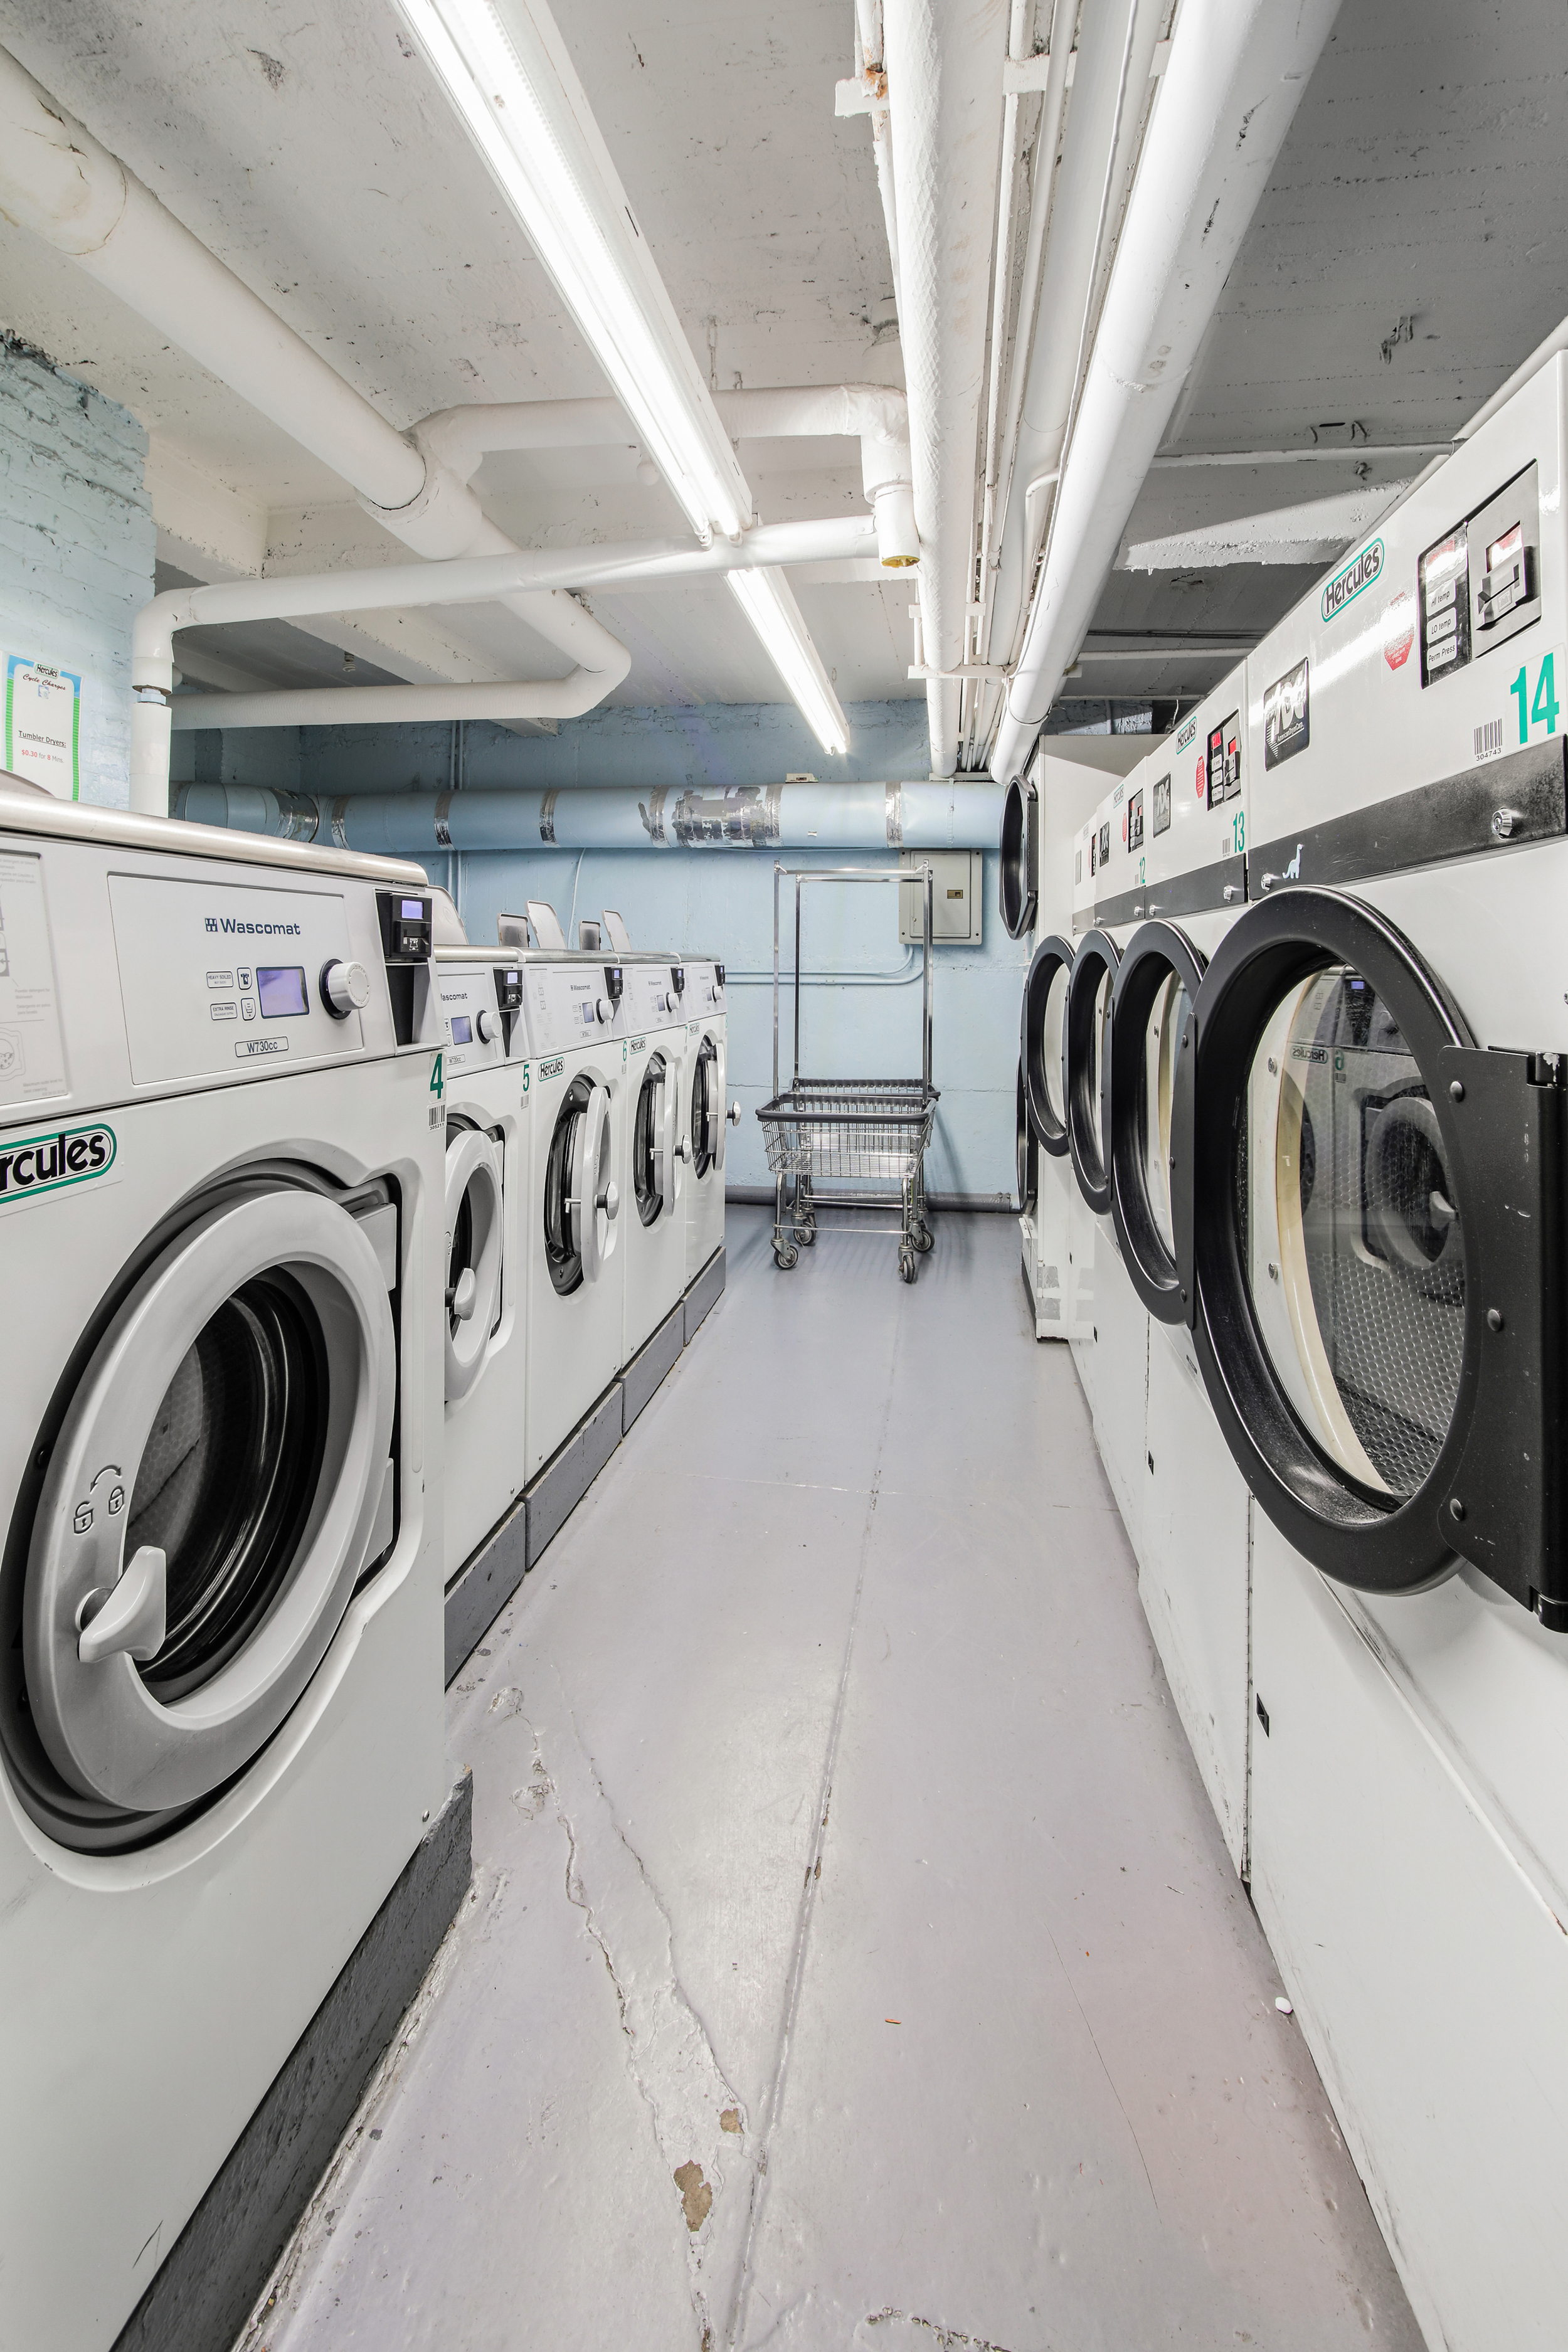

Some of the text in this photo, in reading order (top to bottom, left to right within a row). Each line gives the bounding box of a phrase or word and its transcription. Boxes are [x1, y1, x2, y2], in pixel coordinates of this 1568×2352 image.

[1325, 546, 1379, 614] Hercules
[1431, 591, 1450, 607] HI temp
[1431, 618, 1451, 634] LO temp
[1428, 645, 1455, 663] Perm Press
[36, 664, 58, 677] Hercules
[23, 673, 66, 691] Cycle Charges
[1510, 652, 1560, 744] 14
[18, 730, 66, 747] Tumbler Dryers:
[1177, 721, 1195, 750] Hercules
[21, 750, 38, 758] $0.30
[52, 755, 65, 763] Mins.
[1476, 748, 1502, 761] 304743
[1233, 811, 1244, 853] 13
[1140, 857, 1145, 884] 12
[220, 918, 300, 935] Wascomat
[685, 1026, 687, 1043] 7
[246, 1041, 278, 1053] W730cc
[623, 1041, 627, 1061] 6
[631, 1039, 645, 1051] Hercules
[430, 1053, 443, 1099] 4
[523, 1064, 529, 1091] 5
[540, 1060, 563, 1078] Hercules
